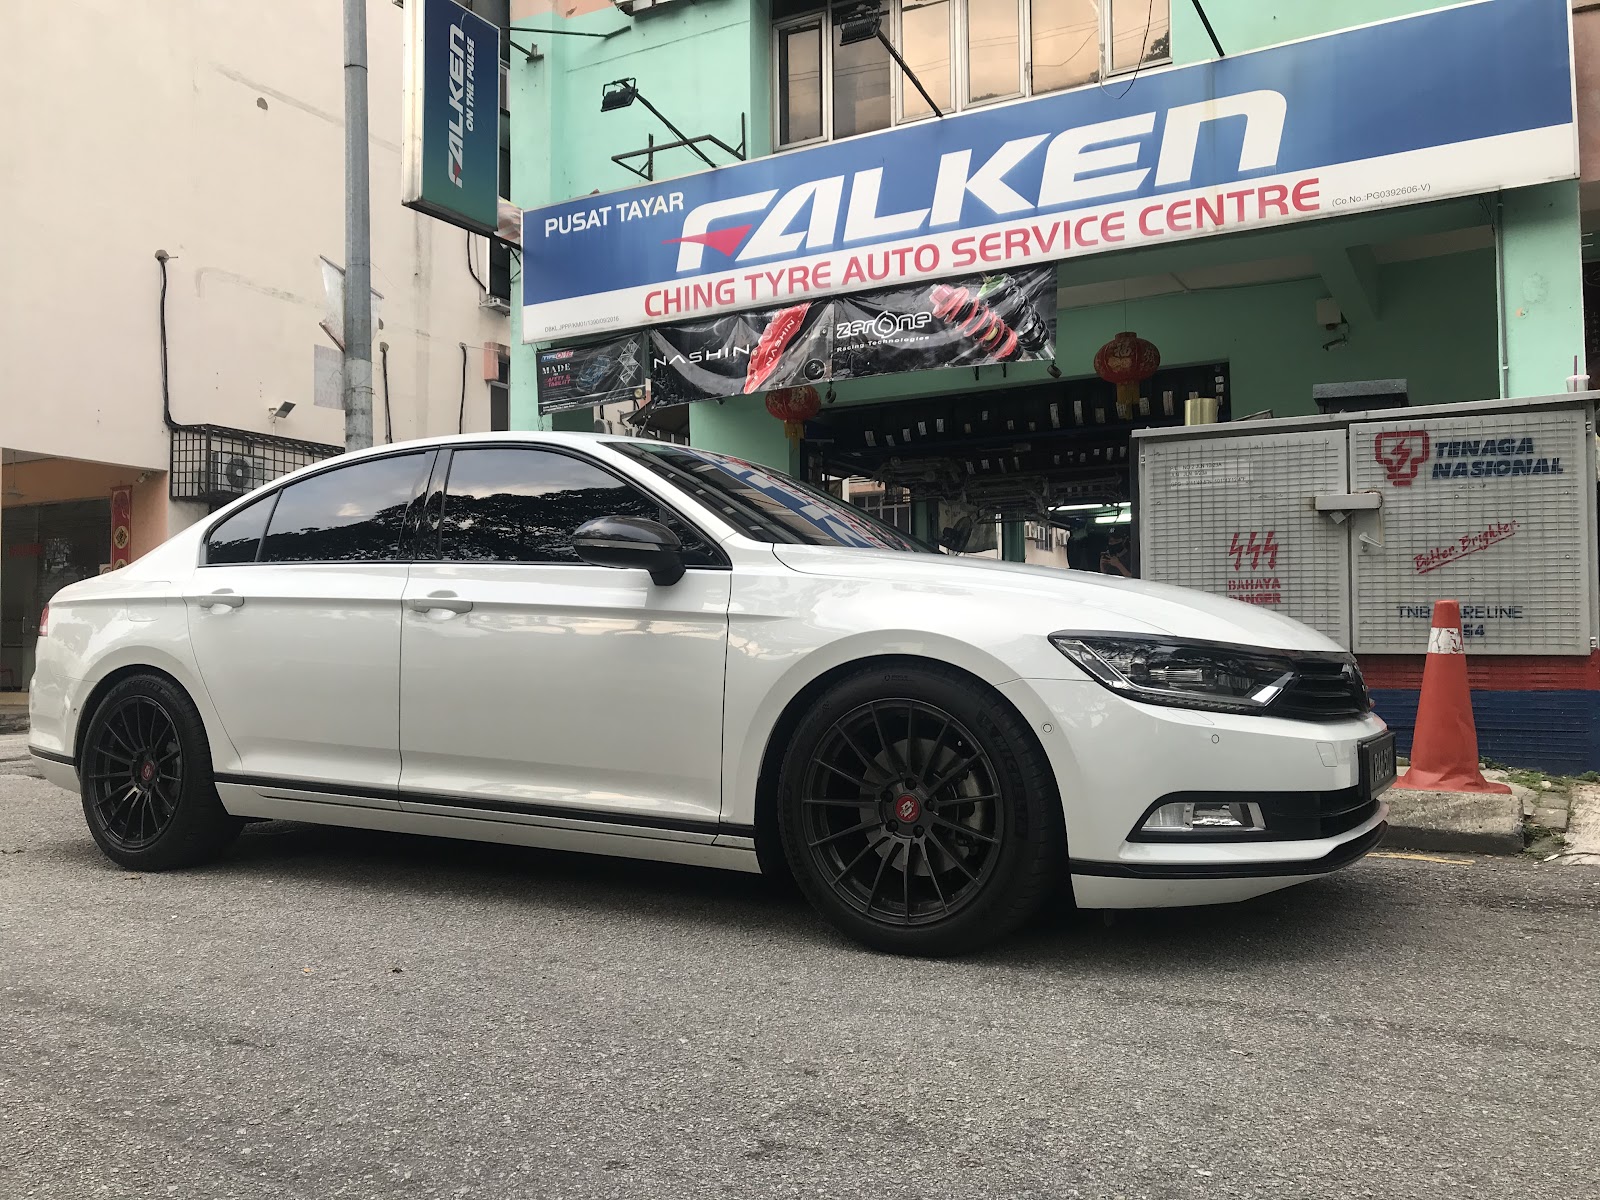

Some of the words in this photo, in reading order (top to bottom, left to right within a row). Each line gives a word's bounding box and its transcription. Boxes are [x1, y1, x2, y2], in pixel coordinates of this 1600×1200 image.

[466, 36, 476, 80] PULSE
[448, 24, 465, 188] FALKEN
[466, 83, 475, 108] THE
[466, 112, 474, 131] ON
[676, 89, 1287, 272] FALKEN
[545, 206, 612, 237] PUSAT
[616, 191, 684, 222] TAYAR
[644, 278, 735, 317] CHING
[744, 261, 831, 301] TYRE
[842, 244, 940, 284] AUTO
[952, 211, 1125, 267] SERVICE
[1139, 177, 1319, 236] CENTRE
[766, 319, 795, 367] NASHIN
[836, 343, 865, 353] Racing
[867, 335, 930, 346] Technologies
[653, 344, 750, 368] NASHIN
[542, 363, 571, 374] MADE
[1435, 437, 1534, 458] TENAGA
[1432, 457, 1563, 479] NASIONAL
[1413, 546, 1458, 571] Better.
[1459, 520, 1521, 552] Brighter.
[1228, 578, 1281, 590] BAHAYA
[1396, 605, 1431, 619] TNB
[1460, 605, 1523, 619] RELINE
